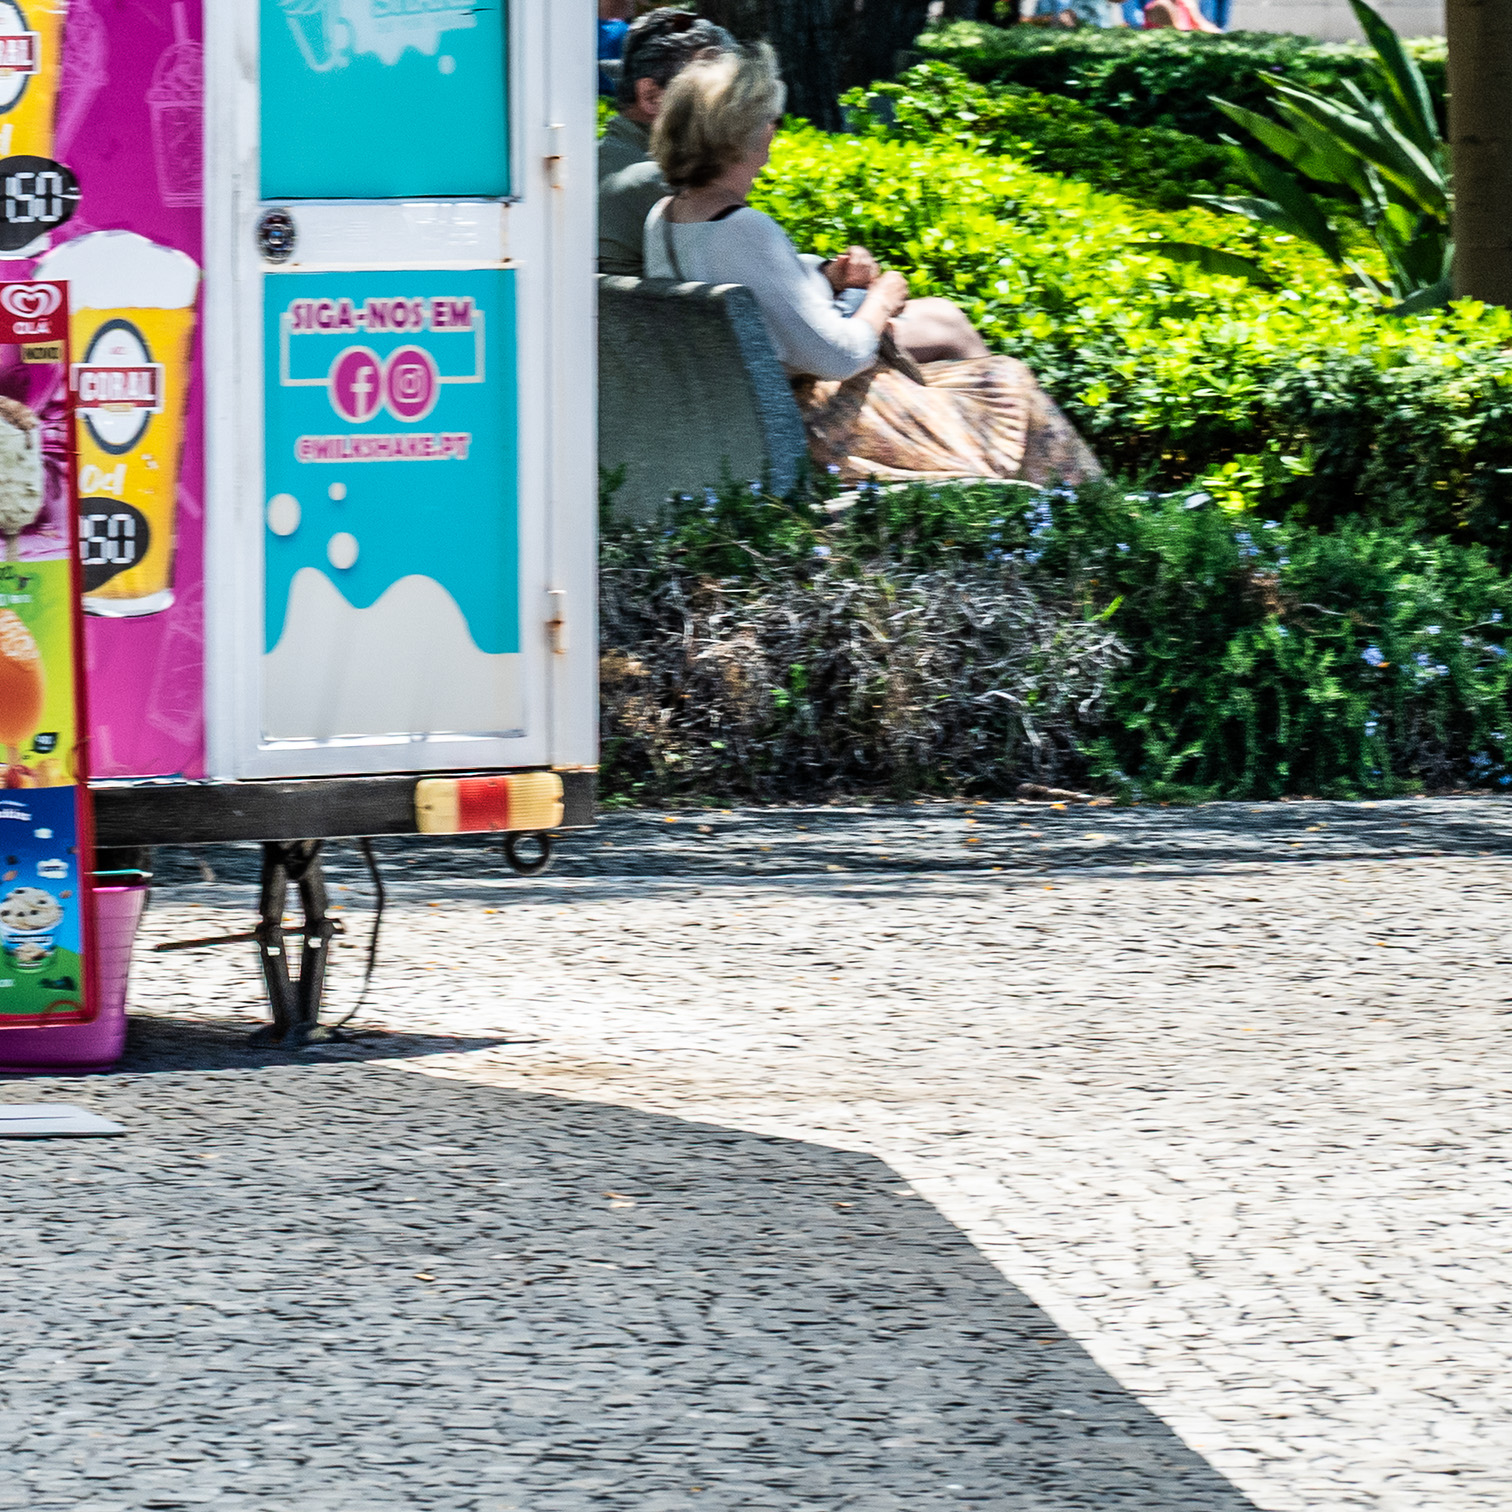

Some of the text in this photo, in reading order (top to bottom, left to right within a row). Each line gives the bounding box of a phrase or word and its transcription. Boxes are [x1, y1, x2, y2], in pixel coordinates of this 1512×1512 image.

[292, 291, 472, 329] SIGA-NOS EM
[79, 371, 156, 402] CORAL
